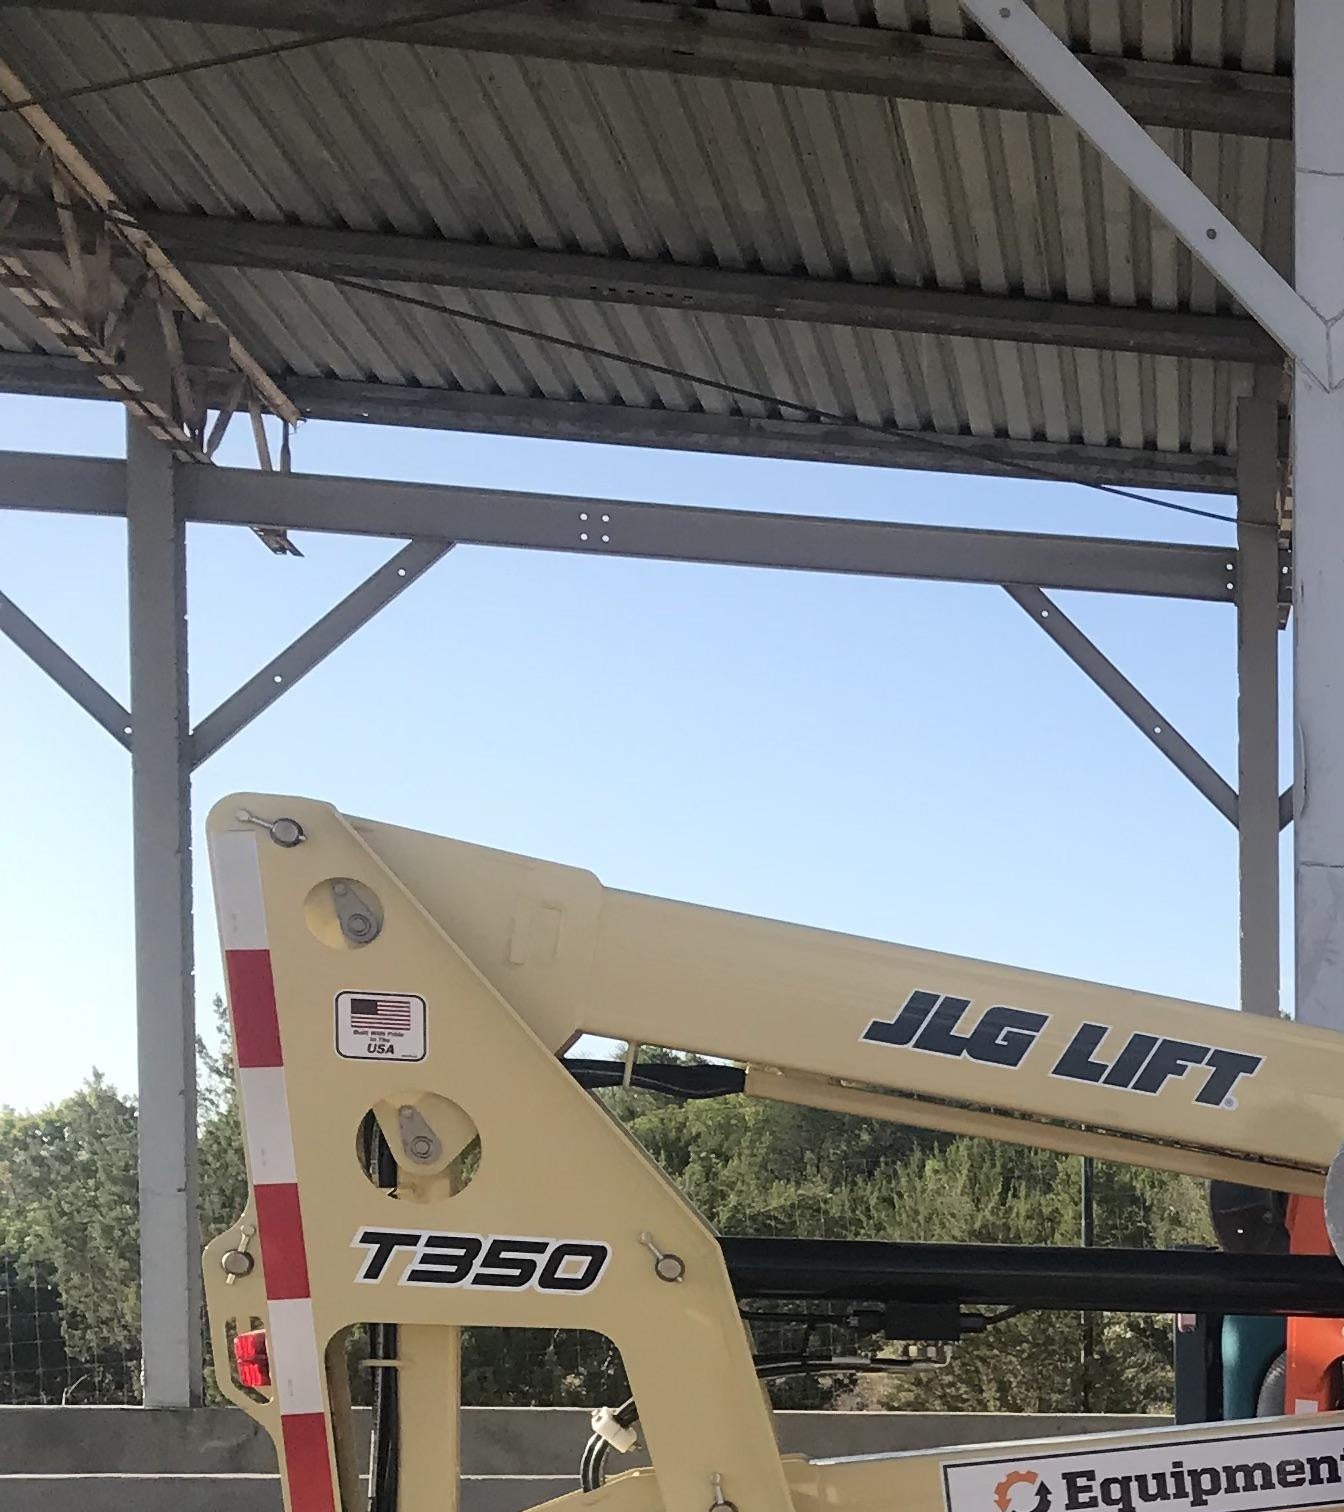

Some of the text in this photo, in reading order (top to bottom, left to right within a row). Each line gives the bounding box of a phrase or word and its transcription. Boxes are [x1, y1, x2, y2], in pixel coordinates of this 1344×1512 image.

[367, 1043, 395, 1055] USA
[861, 990, 1264, 1107] JLG LIFT
[358, 1231, 609, 1292] T350
